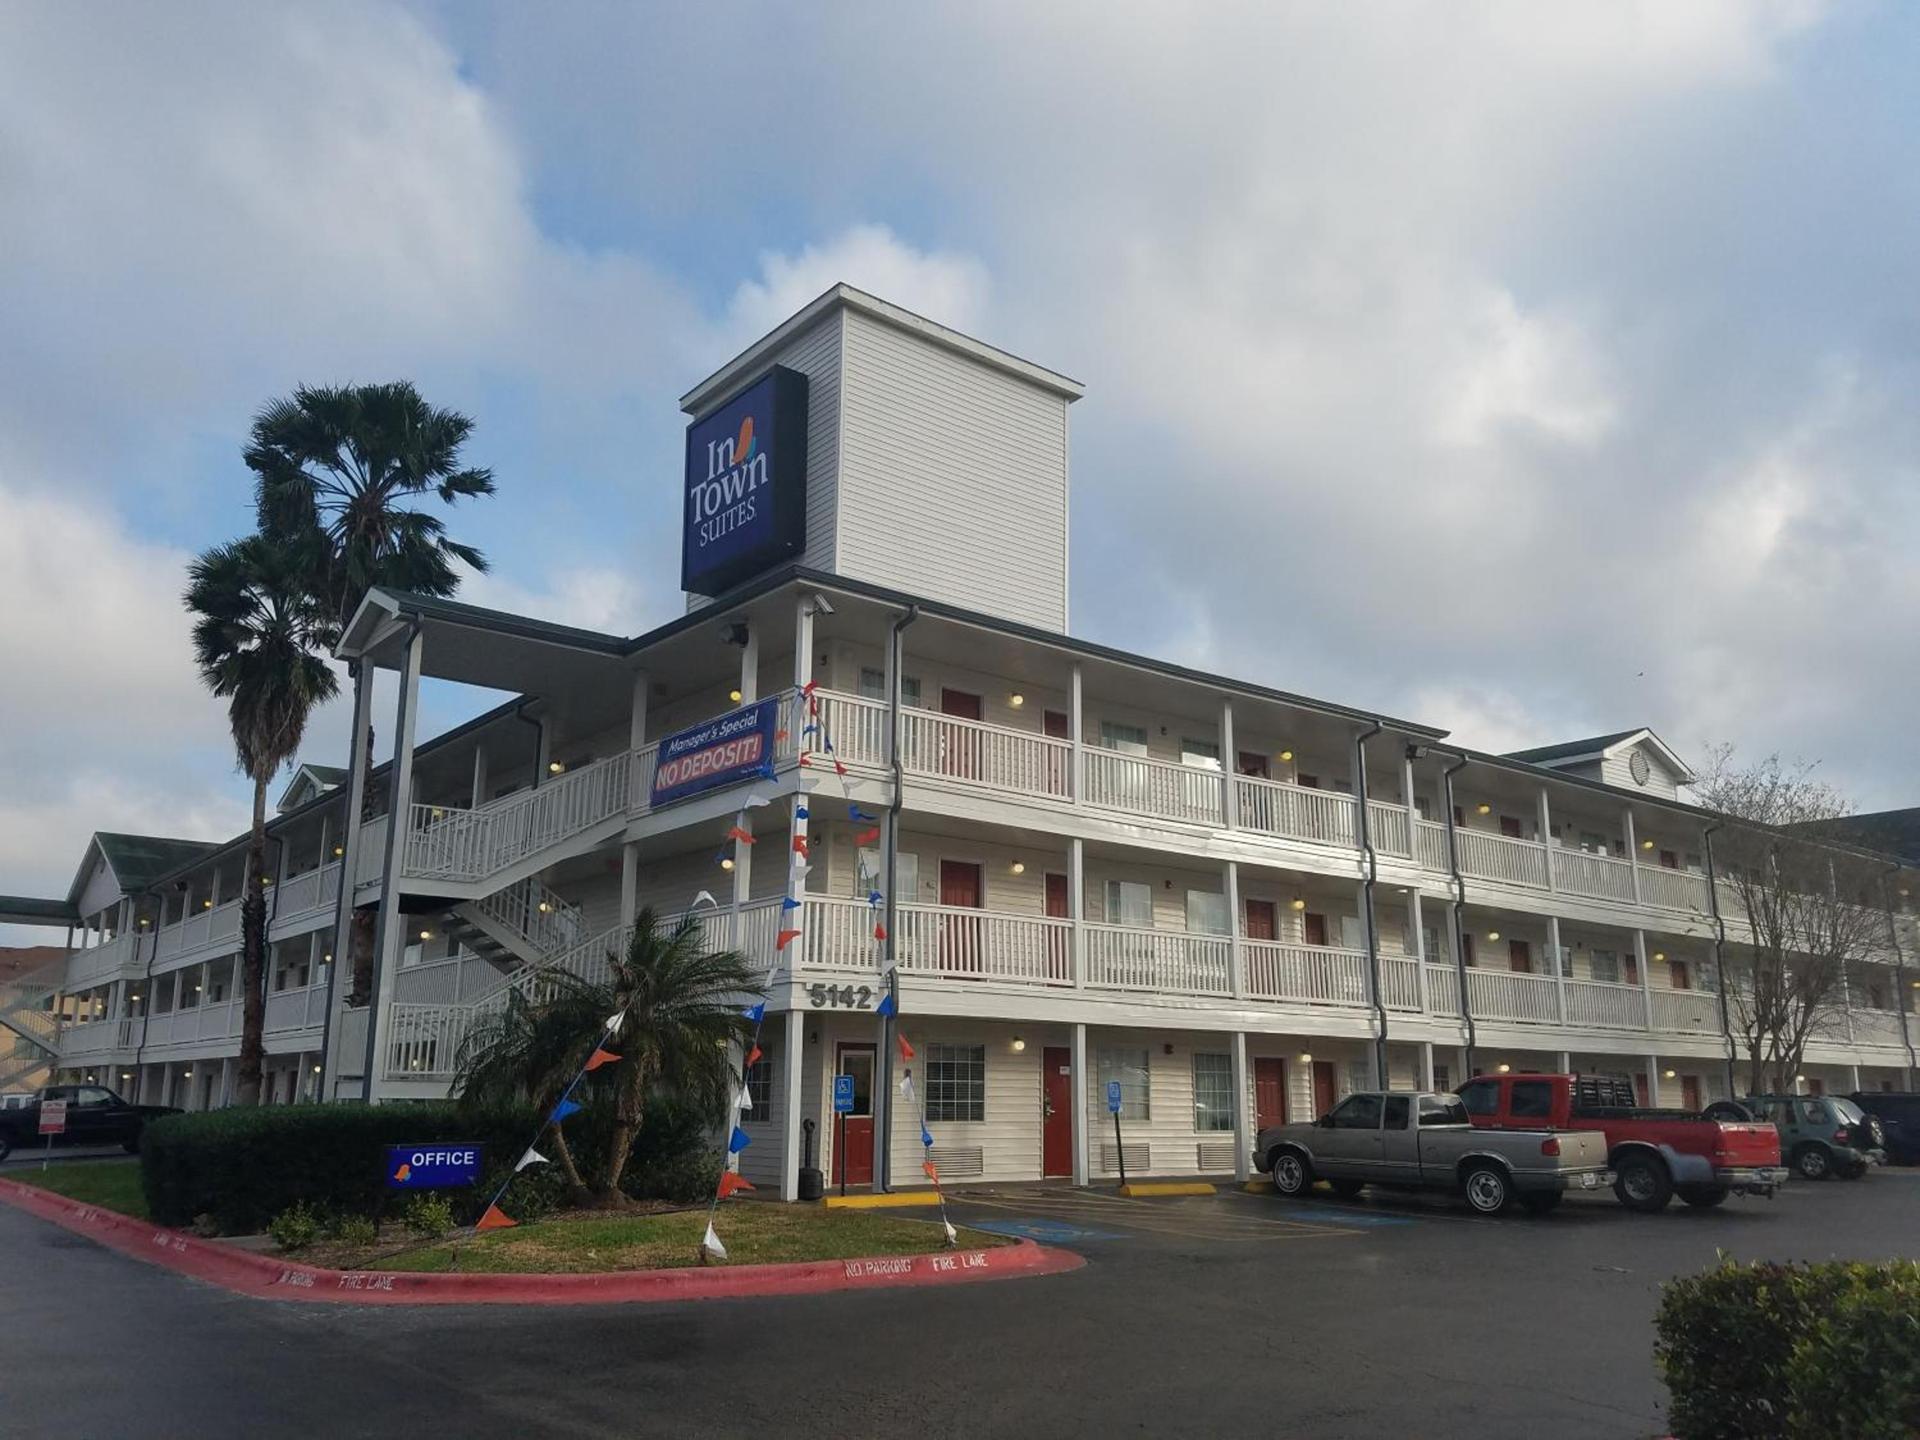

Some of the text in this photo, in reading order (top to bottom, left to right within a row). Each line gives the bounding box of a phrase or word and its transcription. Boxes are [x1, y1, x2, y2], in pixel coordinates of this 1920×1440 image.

[708, 437, 736, 481] In
[700, 496, 755, 547] SUITES
[669, 709, 758, 755] Manager's Special
[656, 737, 759, 788] NO DEPOSIT!
[811, 983, 871, 1009] 5142
[411, 1151, 475, 1167] OFFICE
[846, 1259, 911, 1277] NO PARKING
[933, 1253, 989, 1272] FIRE LANE
[338, 1274, 395, 1290] FIRE LANE
